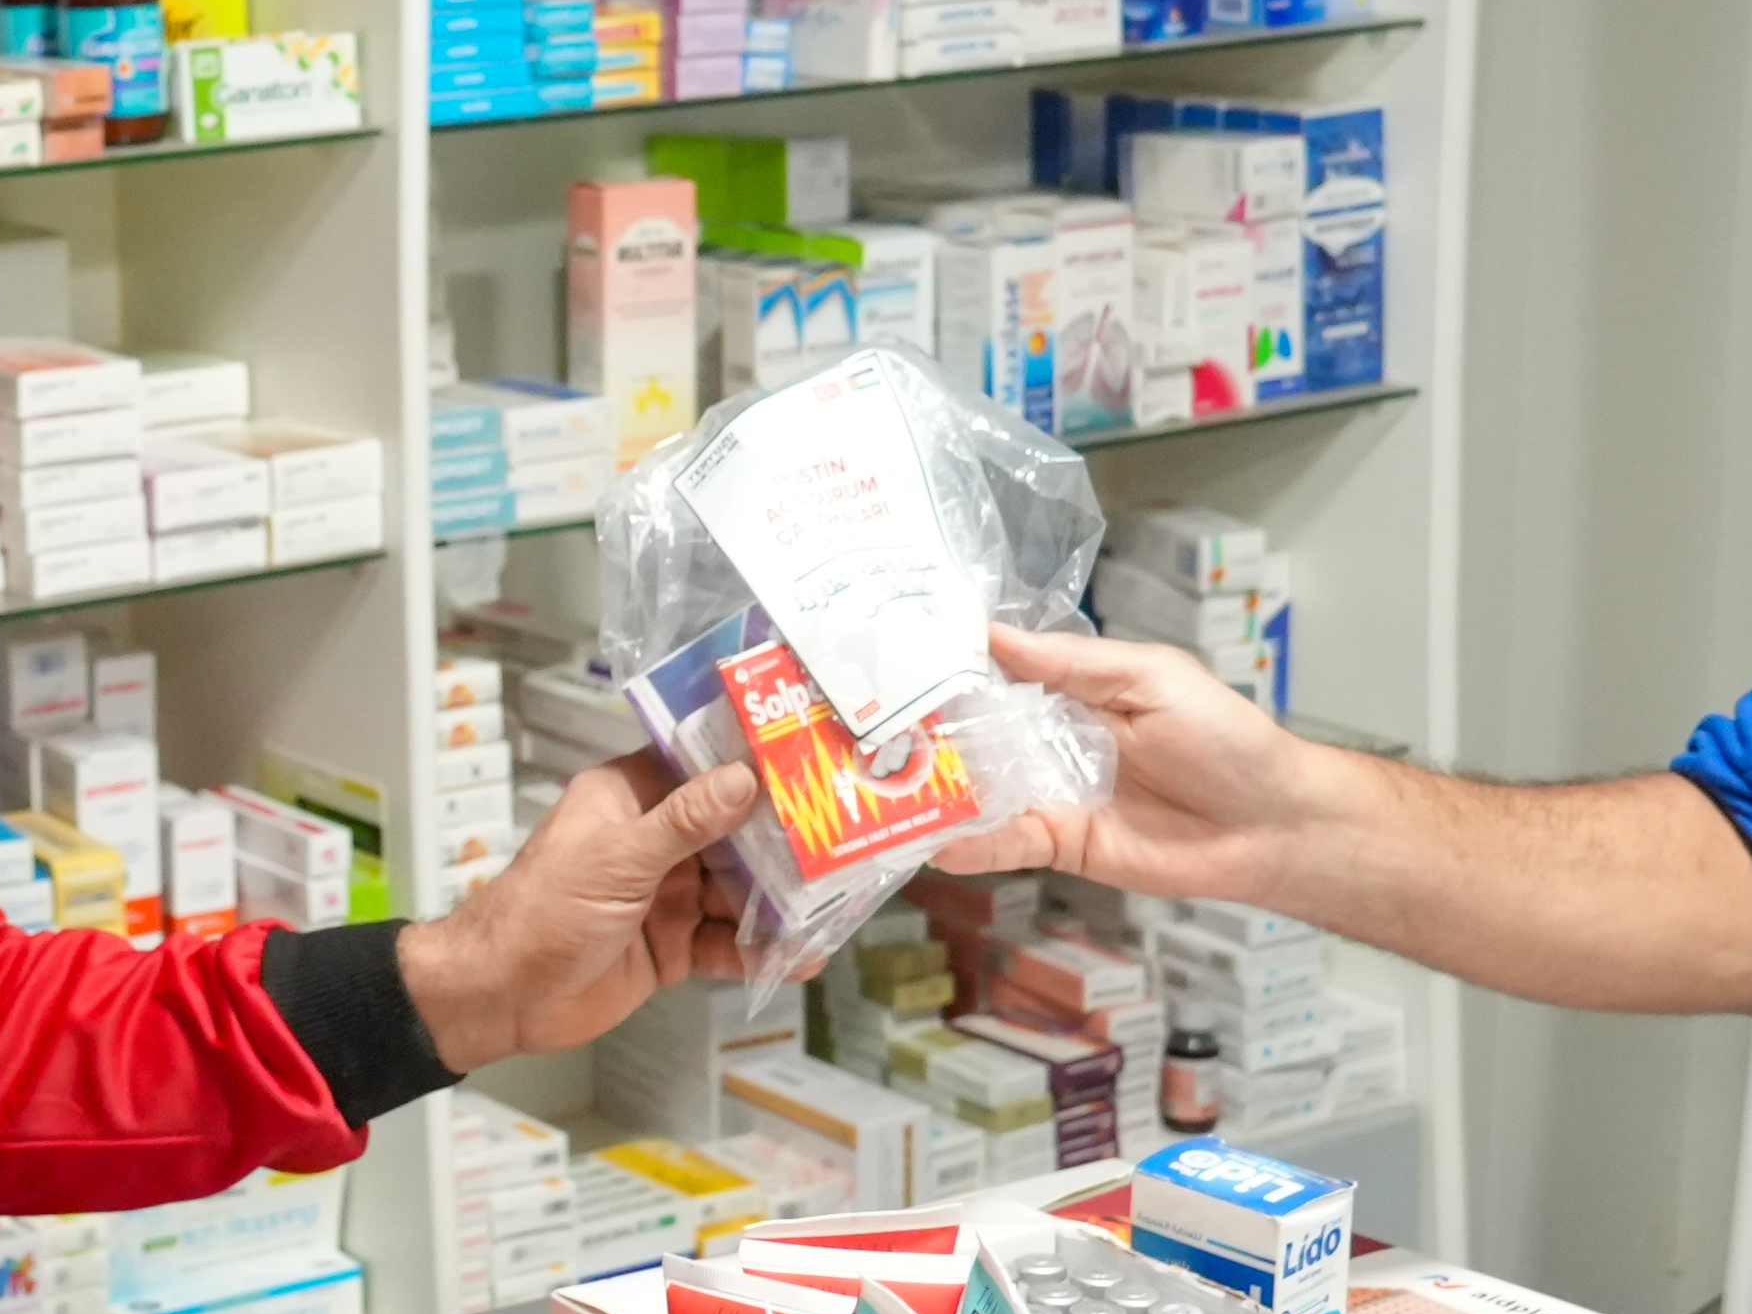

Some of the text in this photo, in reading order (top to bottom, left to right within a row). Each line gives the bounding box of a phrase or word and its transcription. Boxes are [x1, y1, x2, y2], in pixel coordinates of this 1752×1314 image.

[832, 806, 941, 859] STRONG FAST PAIN RELIEF
[1282, 1223, 1342, 1279] Lido
